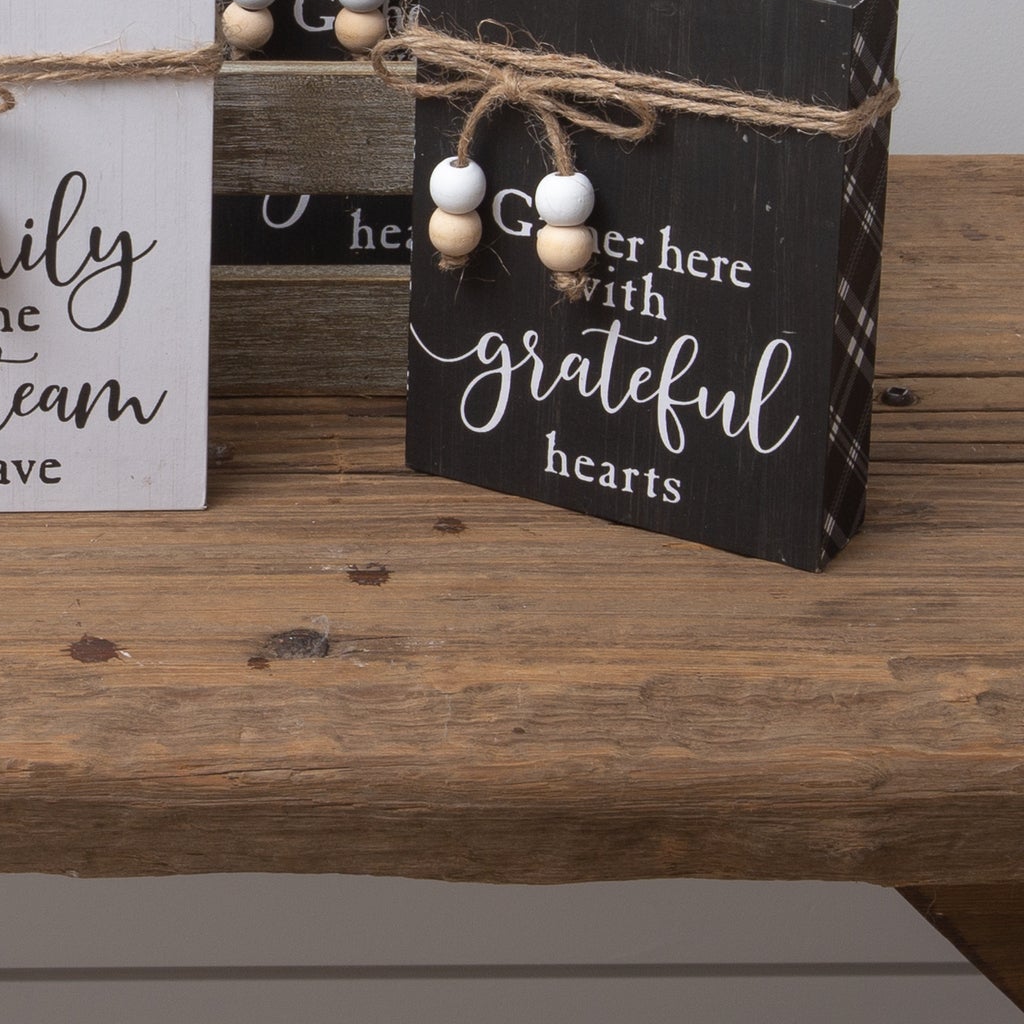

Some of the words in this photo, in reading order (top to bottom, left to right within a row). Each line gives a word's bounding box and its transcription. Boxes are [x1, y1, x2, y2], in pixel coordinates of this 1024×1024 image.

[492, 188, 645, 263] Ger
[658, 225, 753, 288] here
[409, 319, 800, 454] grateful
[544, 430, 682, 504] hearts
